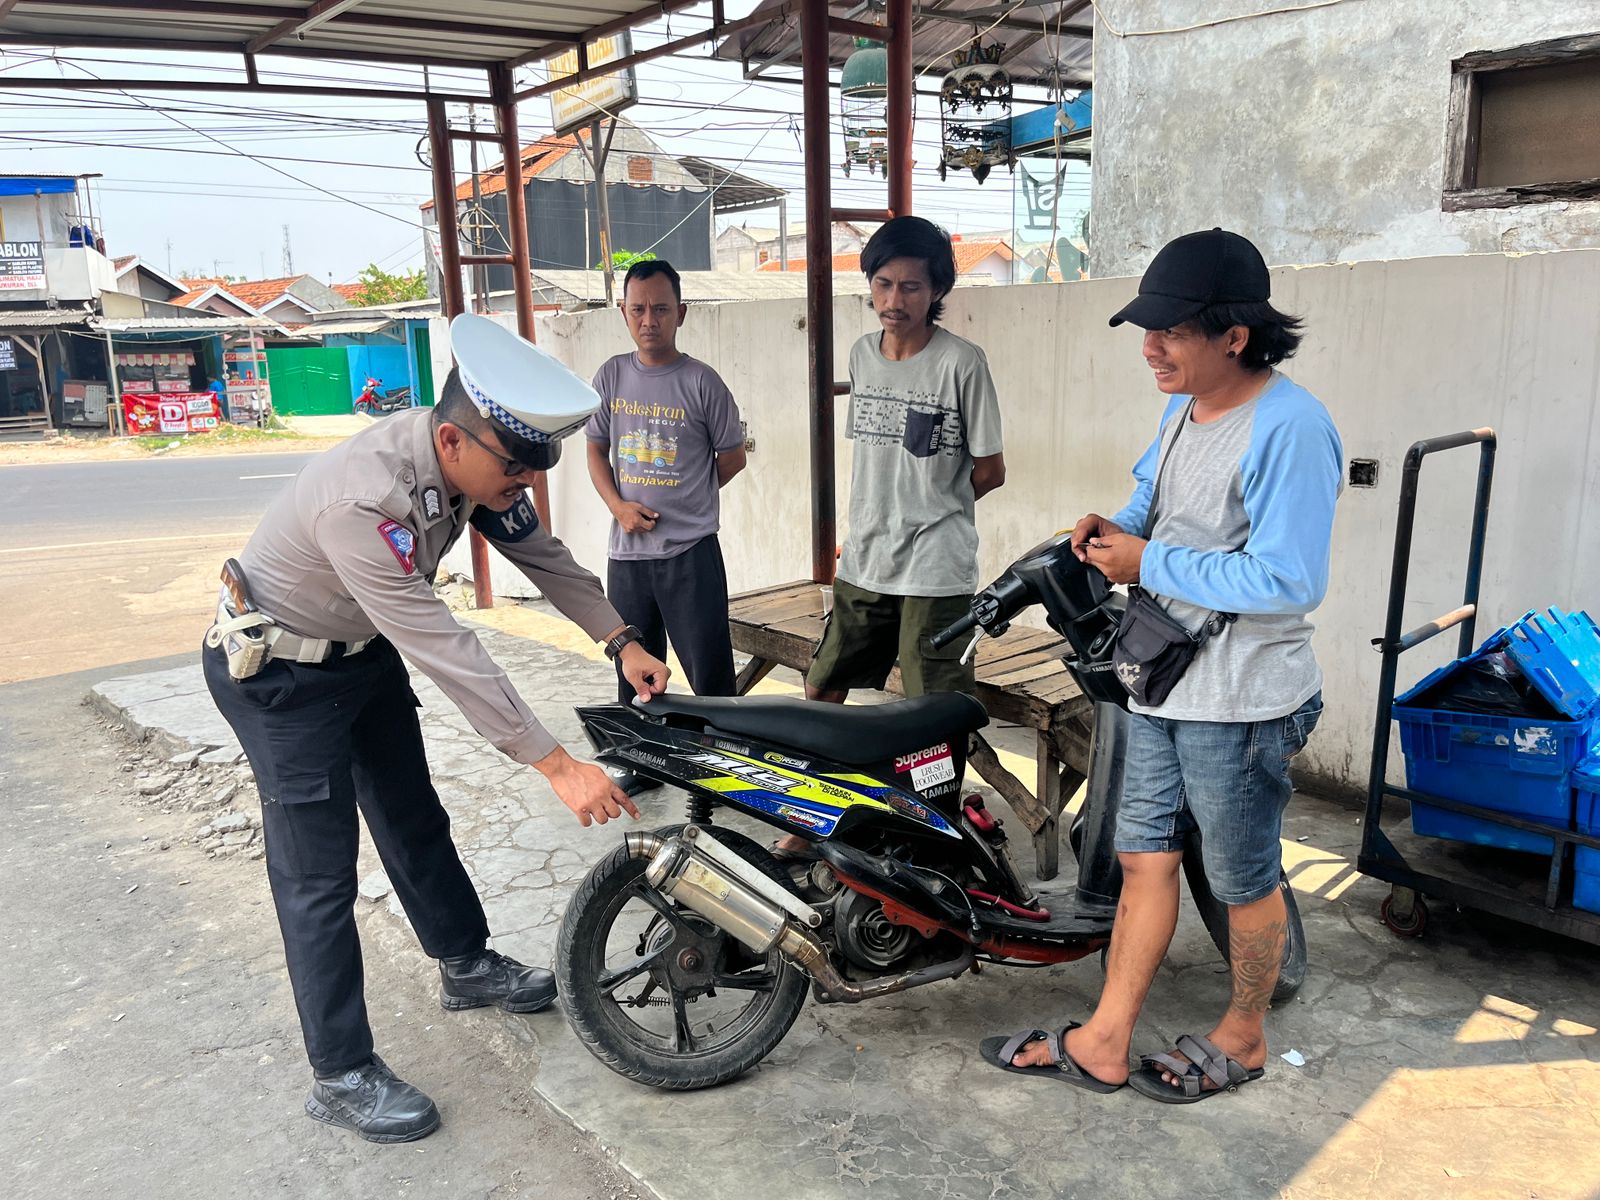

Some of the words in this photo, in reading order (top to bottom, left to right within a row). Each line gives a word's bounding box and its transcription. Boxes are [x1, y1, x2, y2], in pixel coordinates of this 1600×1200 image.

[929, 424, 942, 450] NEVADA
[638, 750, 666, 767] YAMAHA
[895, 742, 948, 767] Supreme
[920, 780, 961, 800] YAMAHA
